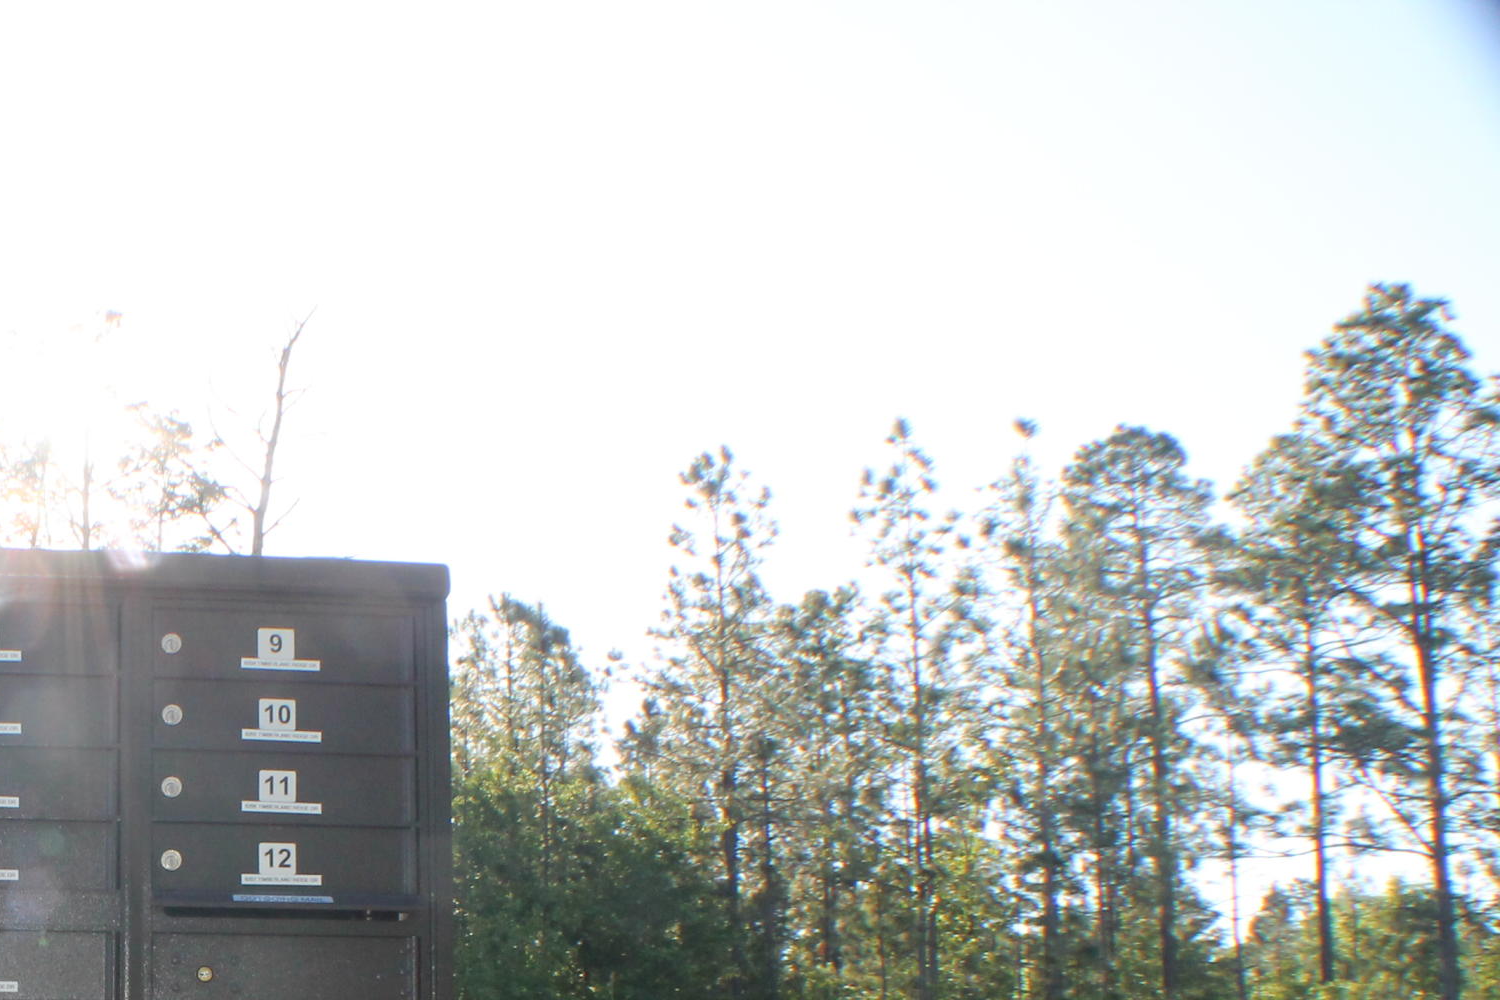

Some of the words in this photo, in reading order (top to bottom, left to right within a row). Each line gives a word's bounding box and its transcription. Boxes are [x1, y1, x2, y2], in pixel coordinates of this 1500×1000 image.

[269, 633, 283, 654] 9
[264, 704, 291, 725] 10
[264, 775, 289, 796] 11
[264, 848, 292, 869] 12
